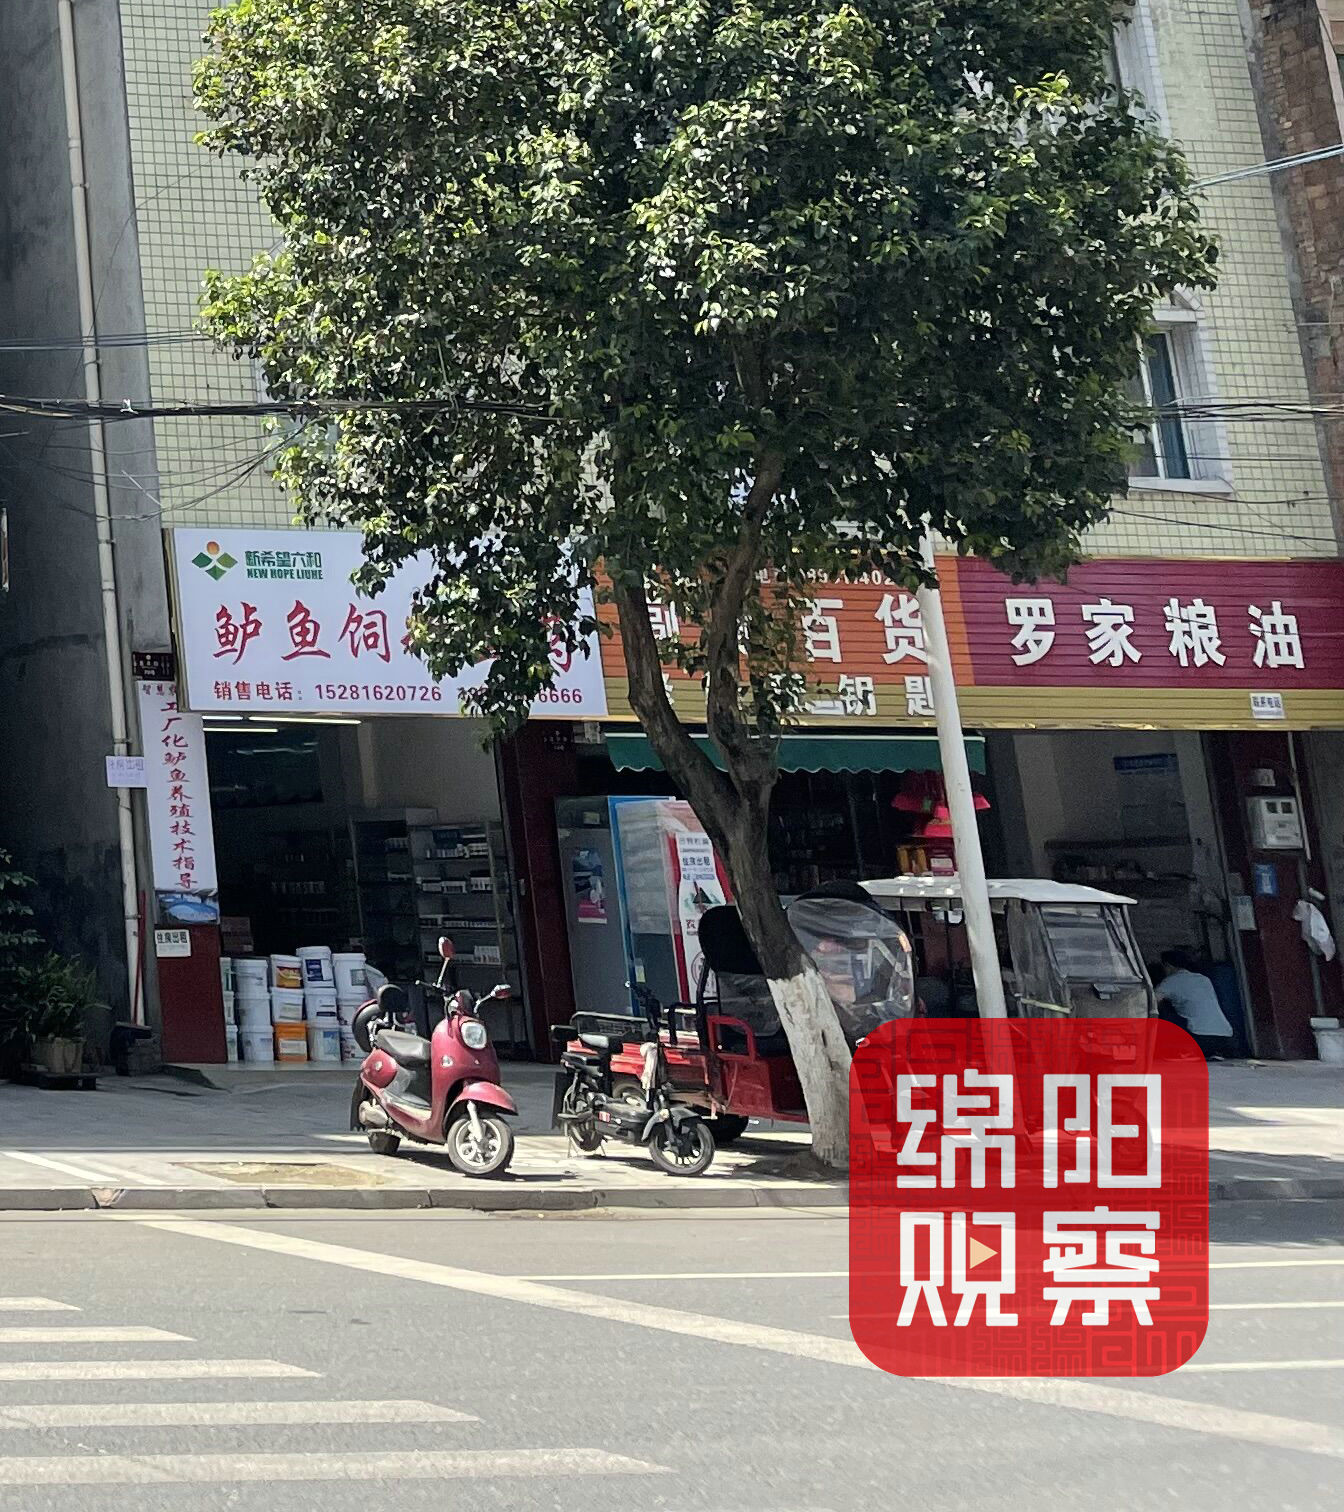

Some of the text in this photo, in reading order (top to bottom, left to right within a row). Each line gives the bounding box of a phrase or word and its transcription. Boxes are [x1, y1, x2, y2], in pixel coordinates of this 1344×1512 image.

[245, 550, 322, 568] 新希望六和
[247, 569, 323, 580] NEW HOPE LIUHE
[1006, 597, 1306, 670] 罗家粮油
[315, 683, 442, 702] 15281620726
